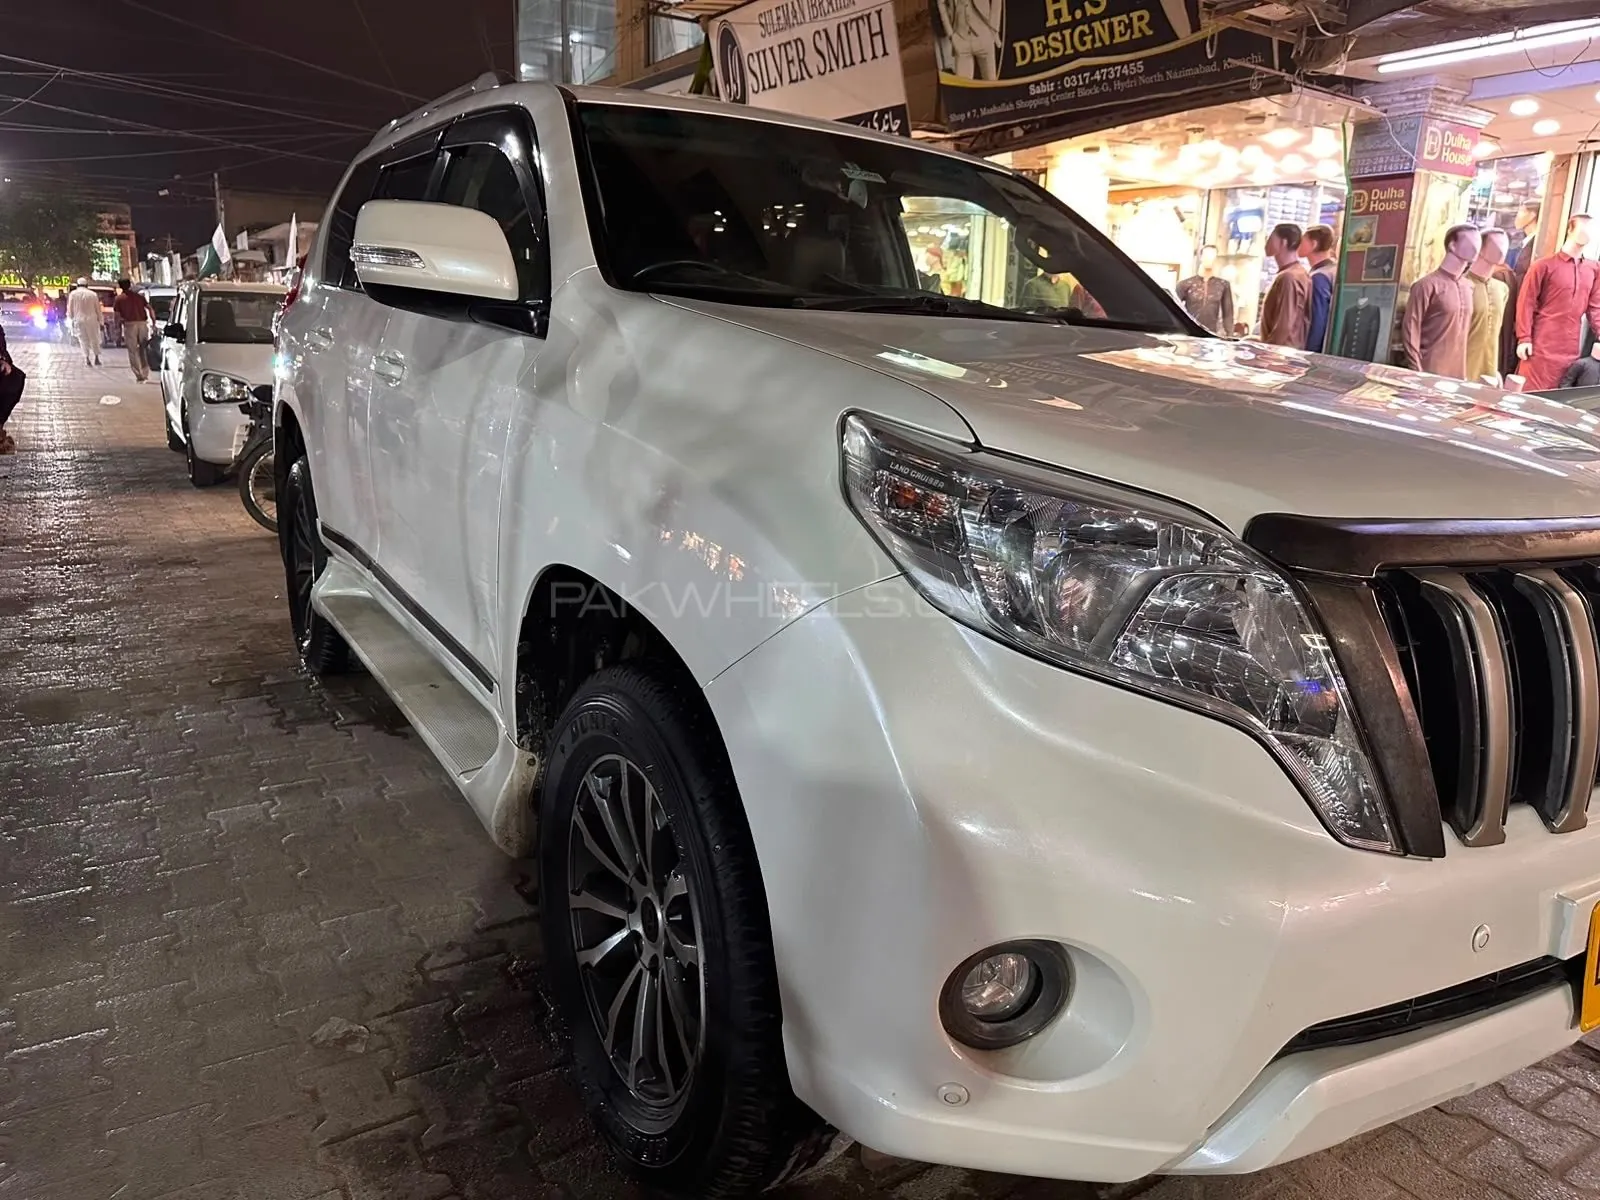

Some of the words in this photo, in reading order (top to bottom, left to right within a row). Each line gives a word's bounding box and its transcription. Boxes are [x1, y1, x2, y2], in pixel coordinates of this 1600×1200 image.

[758, 0, 806, 38] SULEMAN
[806, 0, 856, 21] IBRA
[1013, 9, 1154, 66] DESIGNER
[747, 37, 813, 95] SILVER
[813, 8, 890, 76] SMITH
[1139, 72, 1164, 87] North
[1223, 52, 1265, 70] Kachi.
[1029, 81, 1055, 96] Sabir
[1444, 131, 1472, 149] Dulha
[1441, 148, 1473, 166] House
[1371, 187, 1405, 199] Dulha
[1369, 199, 1407, 212] House
[889, 461, 909, 474] LAND
[910, 470, 945, 489] CRUISER
